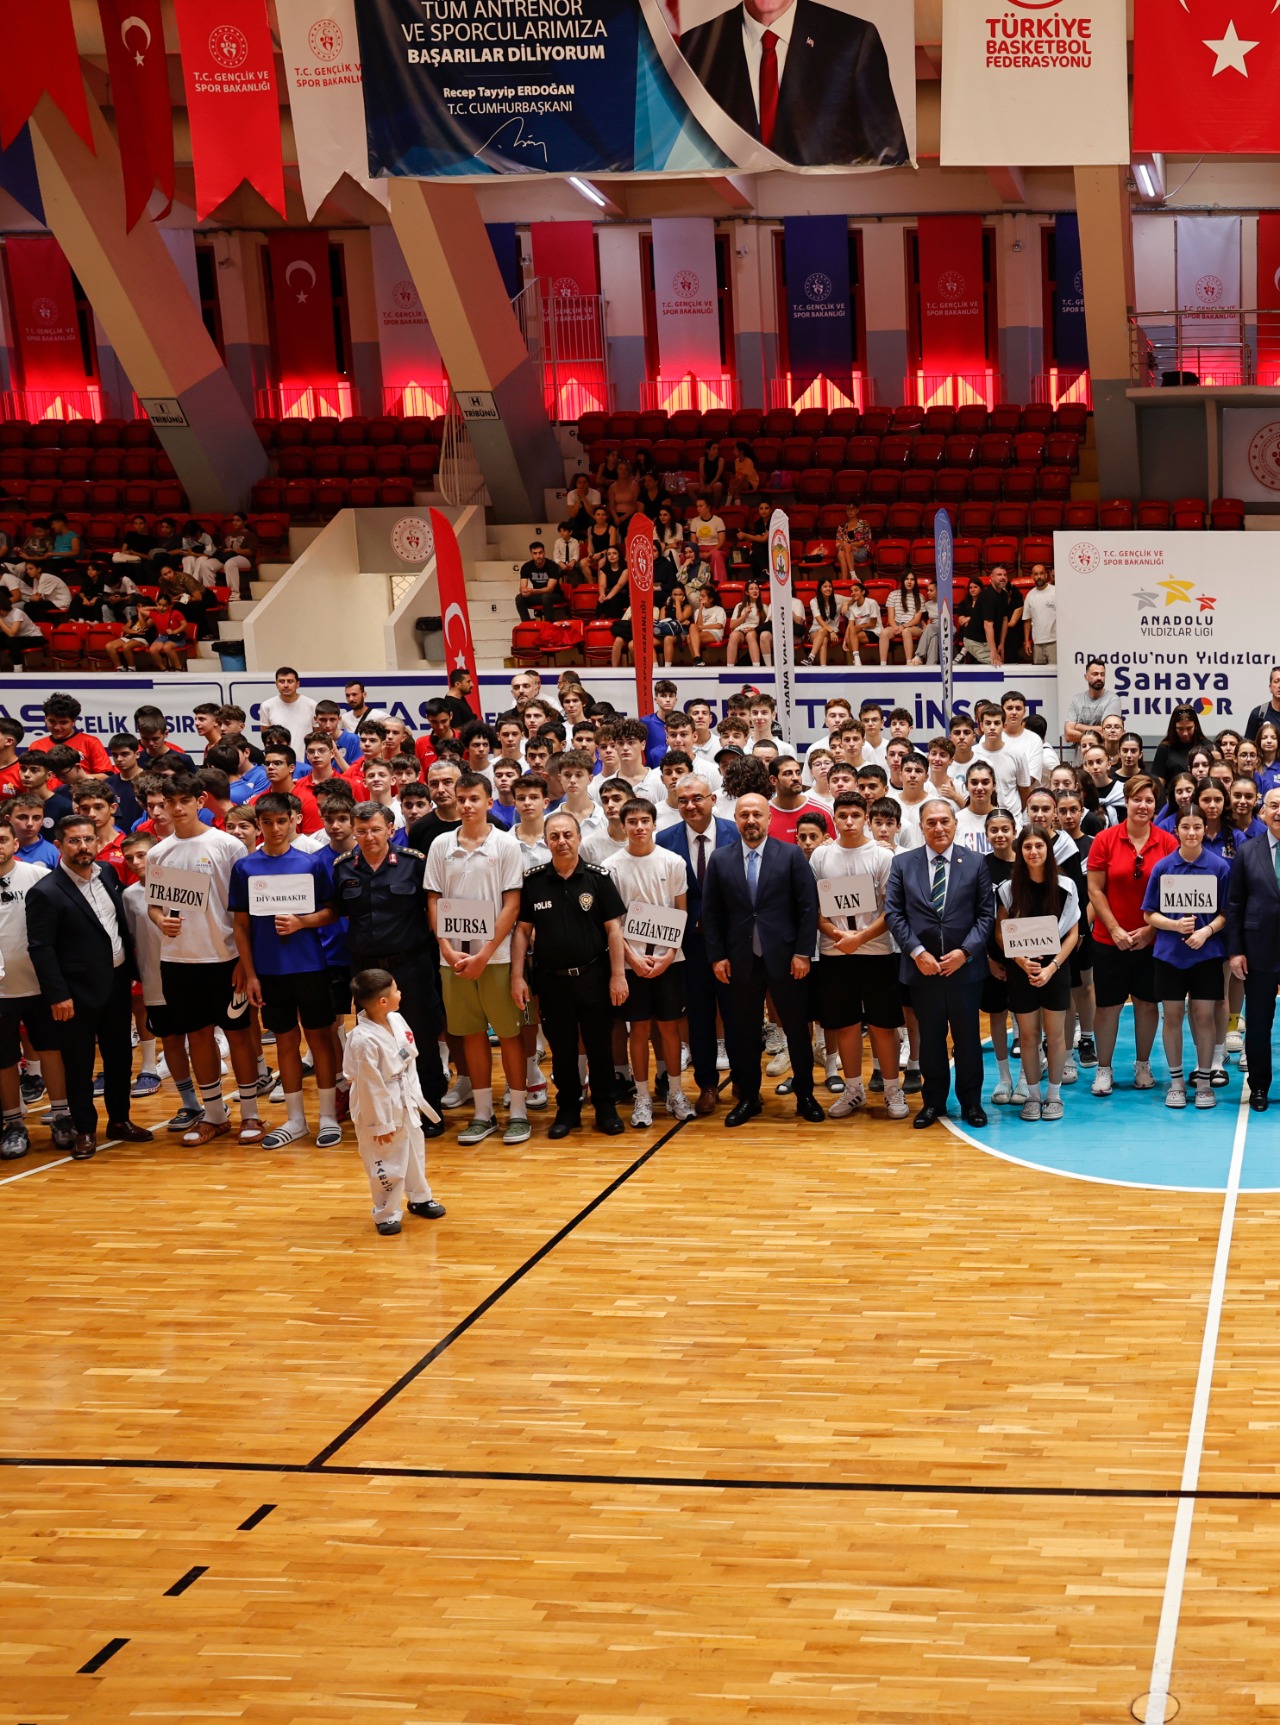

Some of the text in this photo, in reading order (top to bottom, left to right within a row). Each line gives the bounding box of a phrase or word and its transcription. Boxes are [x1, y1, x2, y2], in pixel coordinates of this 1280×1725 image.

[420, 0, 468, 20] TÜM
[401, 19, 608, 42] VE SPORCULARIMIZA
[985, 12, 1092, 39] TÜRKİYE
[985, 40, 1092, 55] BASKETBOL
[407, 43, 606, 68] BAŞARILAR DİLİYORUM
[985, 56, 1092, 68] FEDERASYONU
[294, 63, 362, 76] T.C. GENÇLİK V
[193, 70, 269, 84] T.C. GENÇLİK VE
[296, 74, 363, 88] SPOR BAKANLI
[194, 81, 271, 93] SPOR BAKANLIĞI
[443, 82, 575, 100] Recep Tayyip ERDOĞAN
[447, 100, 573, 116] T.C. CUMHURBAŞKANI
[471, 397, 481, 405] H
[1118, 549, 1152, 558] GENÇLİK
[512, 564, 519, 572] C
[1140, 615, 1213, 626] ANADOLU
[1140, 627, 1192, 637] YILDIZLAR
[1196, 651, 1276, 665] Yıldızları
[782, 670, 791, 718] ADANA
[149, 883, 204, 907] TRABZON
[256, 894, 307, 902] DİYARBAKIR
[834, 893, 861, 910] VAN
[1164, 888, 1214, 908] MANİSA
[444, 917, 488, 934] BURSA
[627, 918, 681, 943] GAZİANTEP
[1009, 936, 1054, 948] BATMAN
